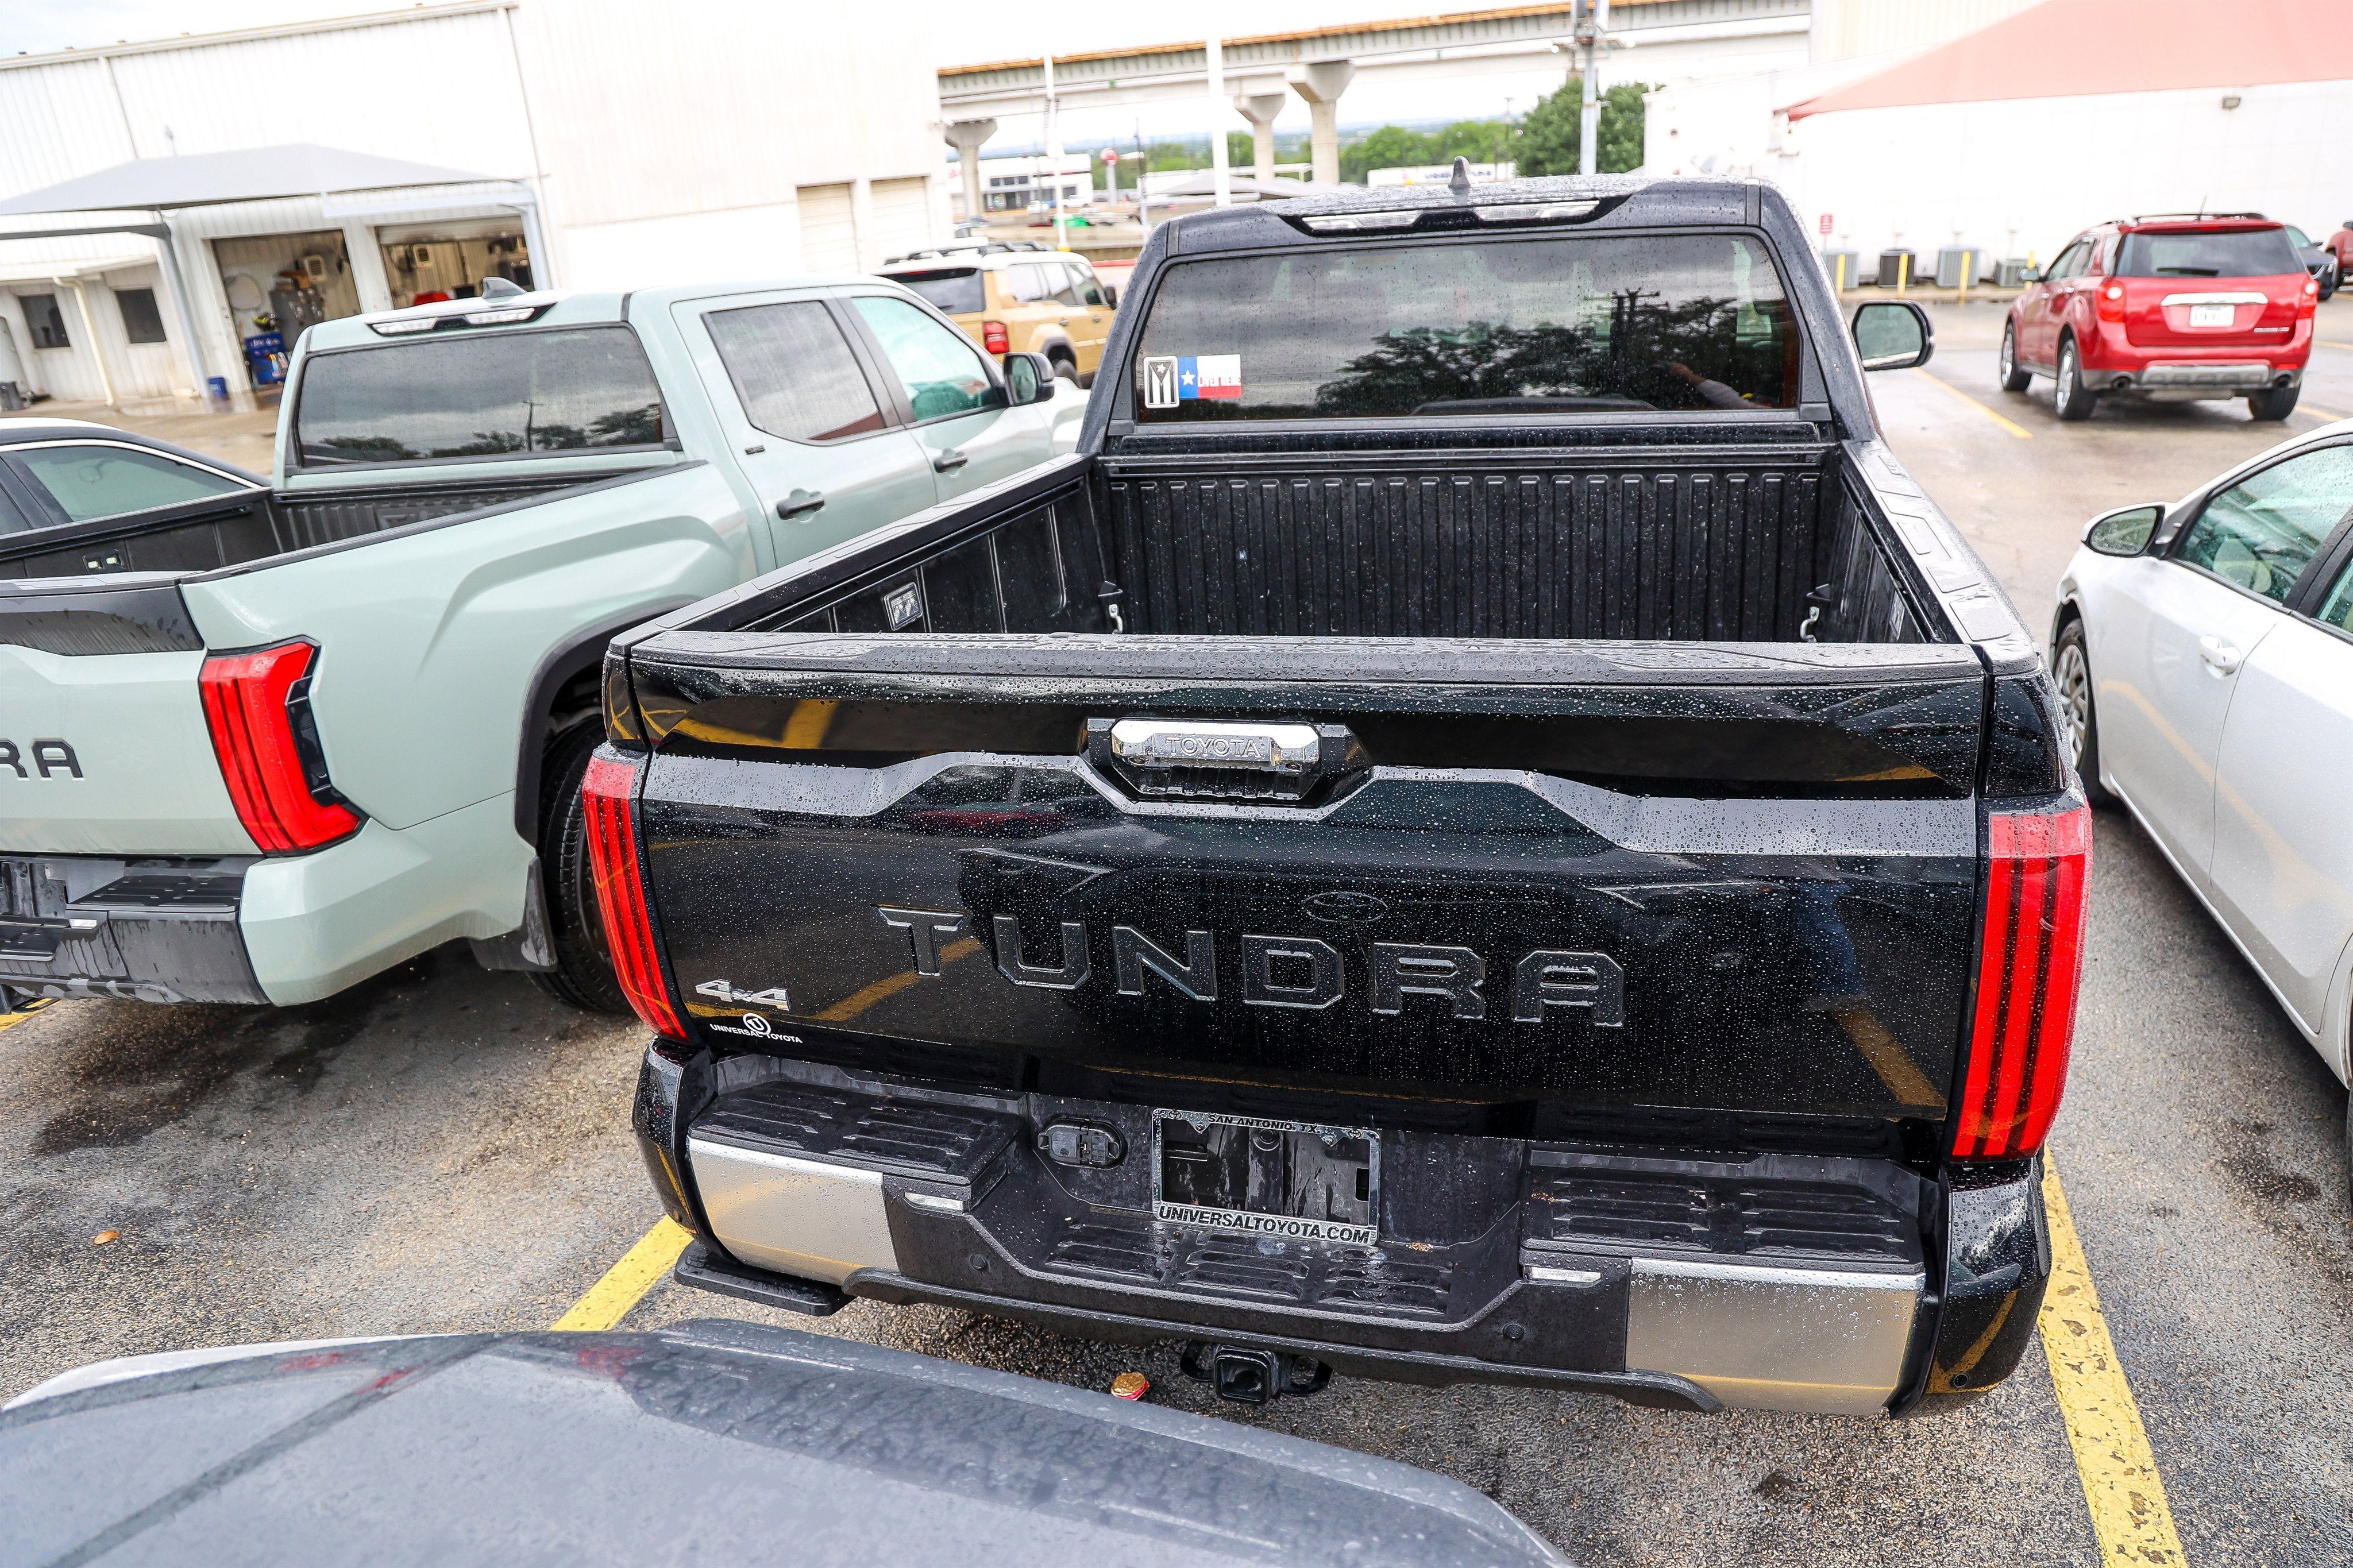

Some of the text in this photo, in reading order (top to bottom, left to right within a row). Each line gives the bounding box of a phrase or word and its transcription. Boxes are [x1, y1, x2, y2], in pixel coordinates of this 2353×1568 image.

[1166, 737, 1262, 758] TOYOTA
[877, 905, 1625, 1027] TUNDRA
[709, 1024, 803, 1044] UNIVERSAL TOYOTA
[1209, 1114, 1321, 1134] SAN ANTONIO, TX.
[1160, 1206, 1371, 1244] UNIVERSALTOYOTA.COM
